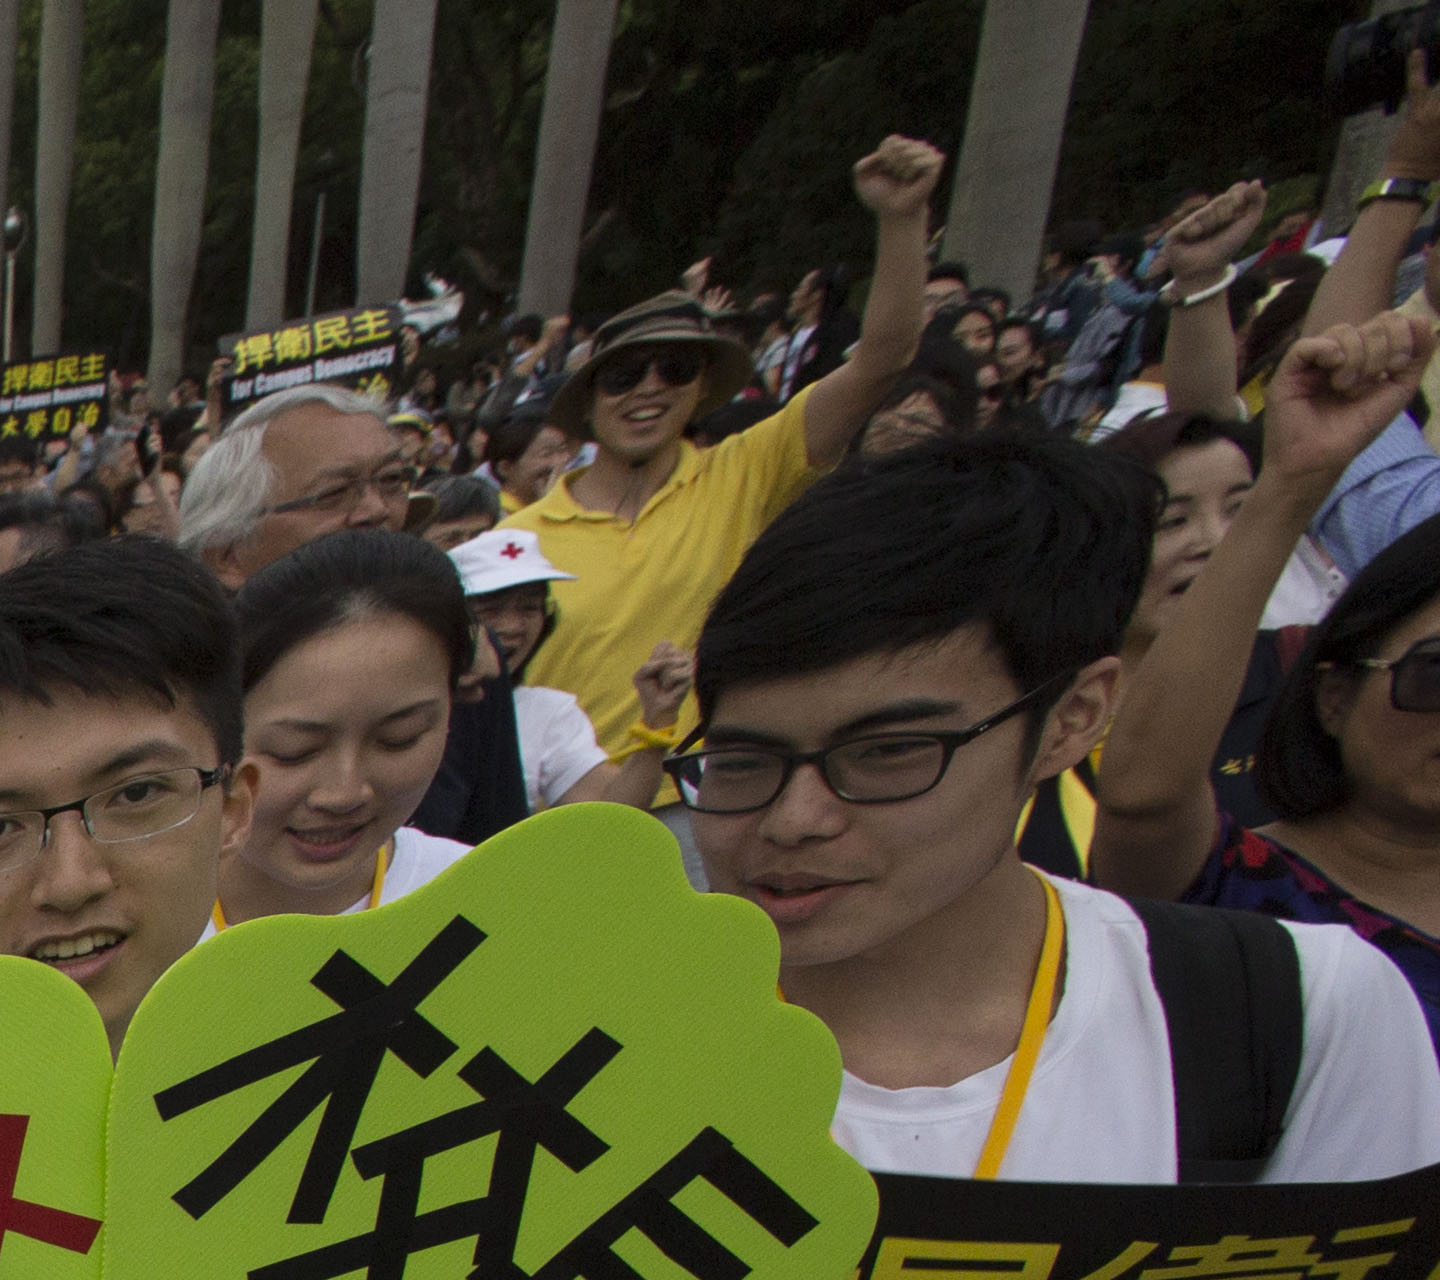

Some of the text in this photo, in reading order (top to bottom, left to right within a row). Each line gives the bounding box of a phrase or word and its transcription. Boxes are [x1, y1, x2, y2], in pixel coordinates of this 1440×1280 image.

[233, 309, 393, 374] 捍衛民主
[1, 353, 106, 396] 捍衛民主
